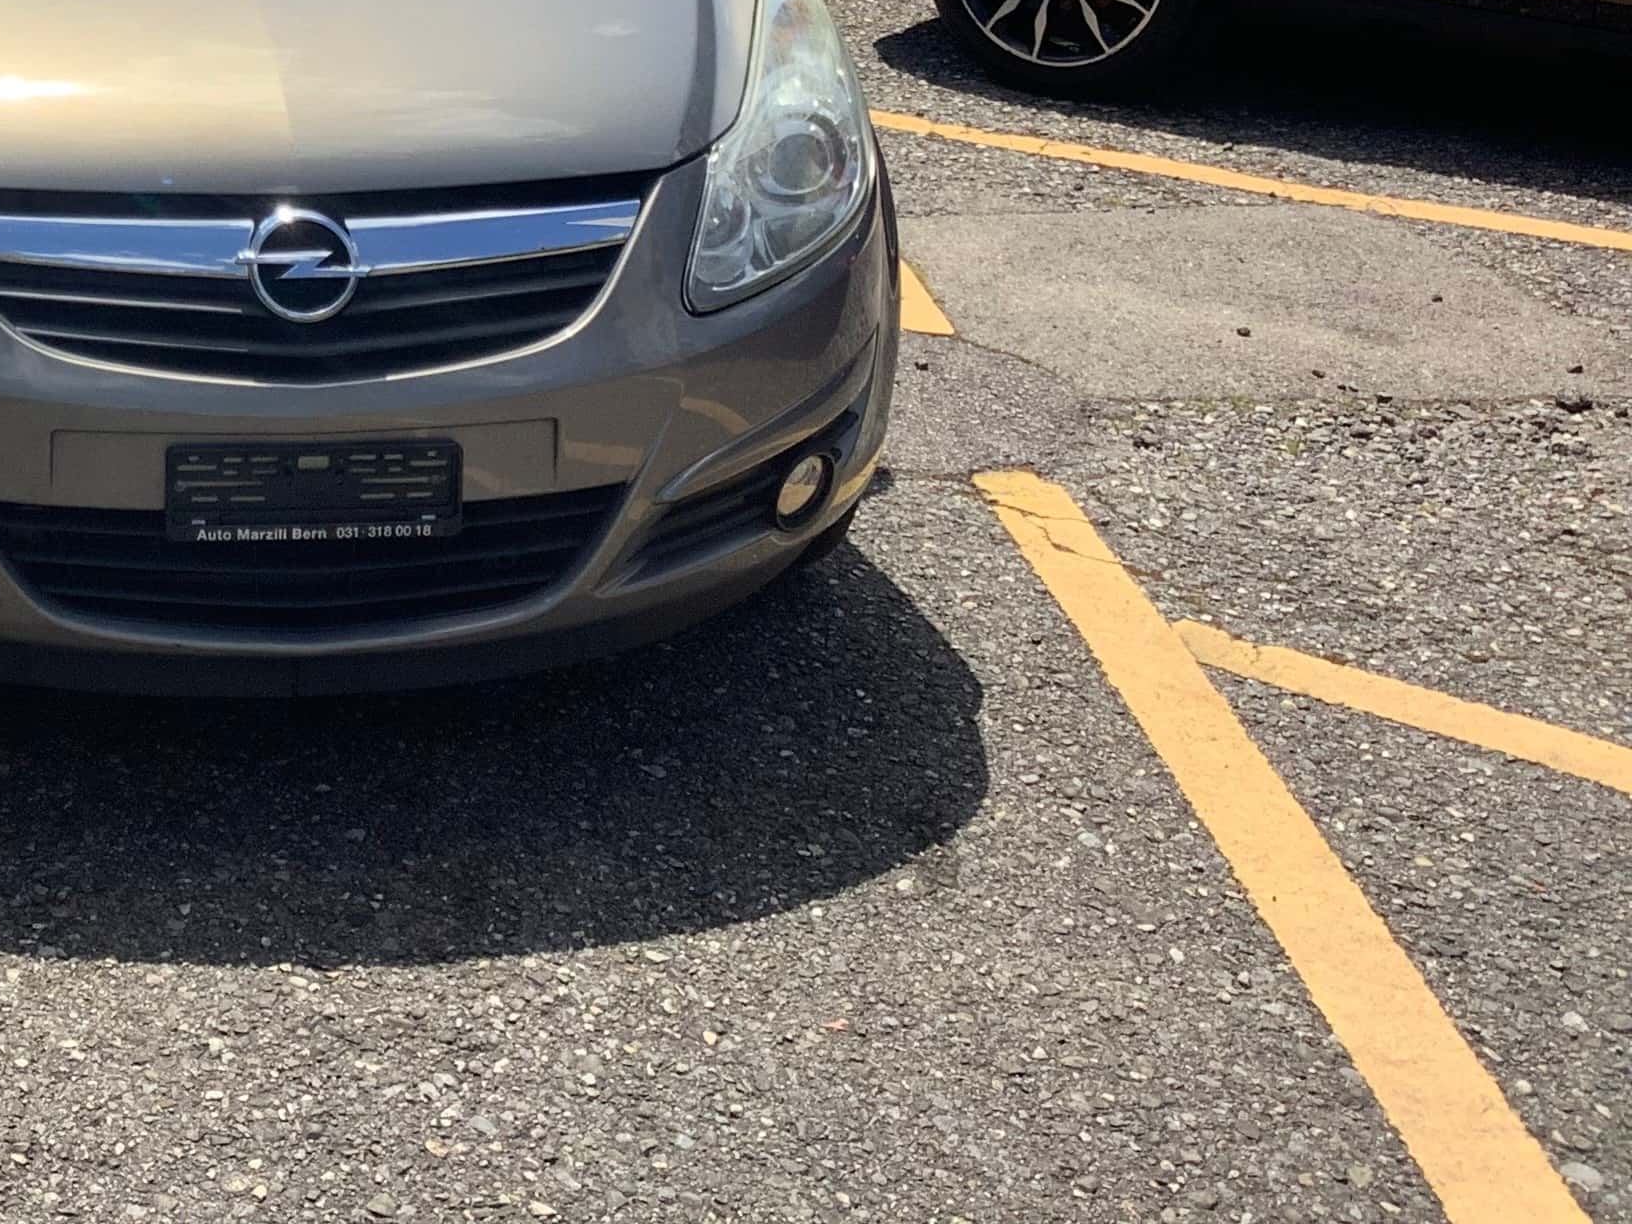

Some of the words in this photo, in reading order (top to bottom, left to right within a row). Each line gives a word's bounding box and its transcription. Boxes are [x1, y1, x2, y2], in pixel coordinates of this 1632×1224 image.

[196, 529, 232, 541] Auto
[237, 528, 287, 541] Marzili
[292, 528, 327, 540] Bern
[336, 526, 359, 539] 031
[368, 525, 392, 537] 318
[396, 525, 412, 537] 00
[416, 525, 432, 536] 18
